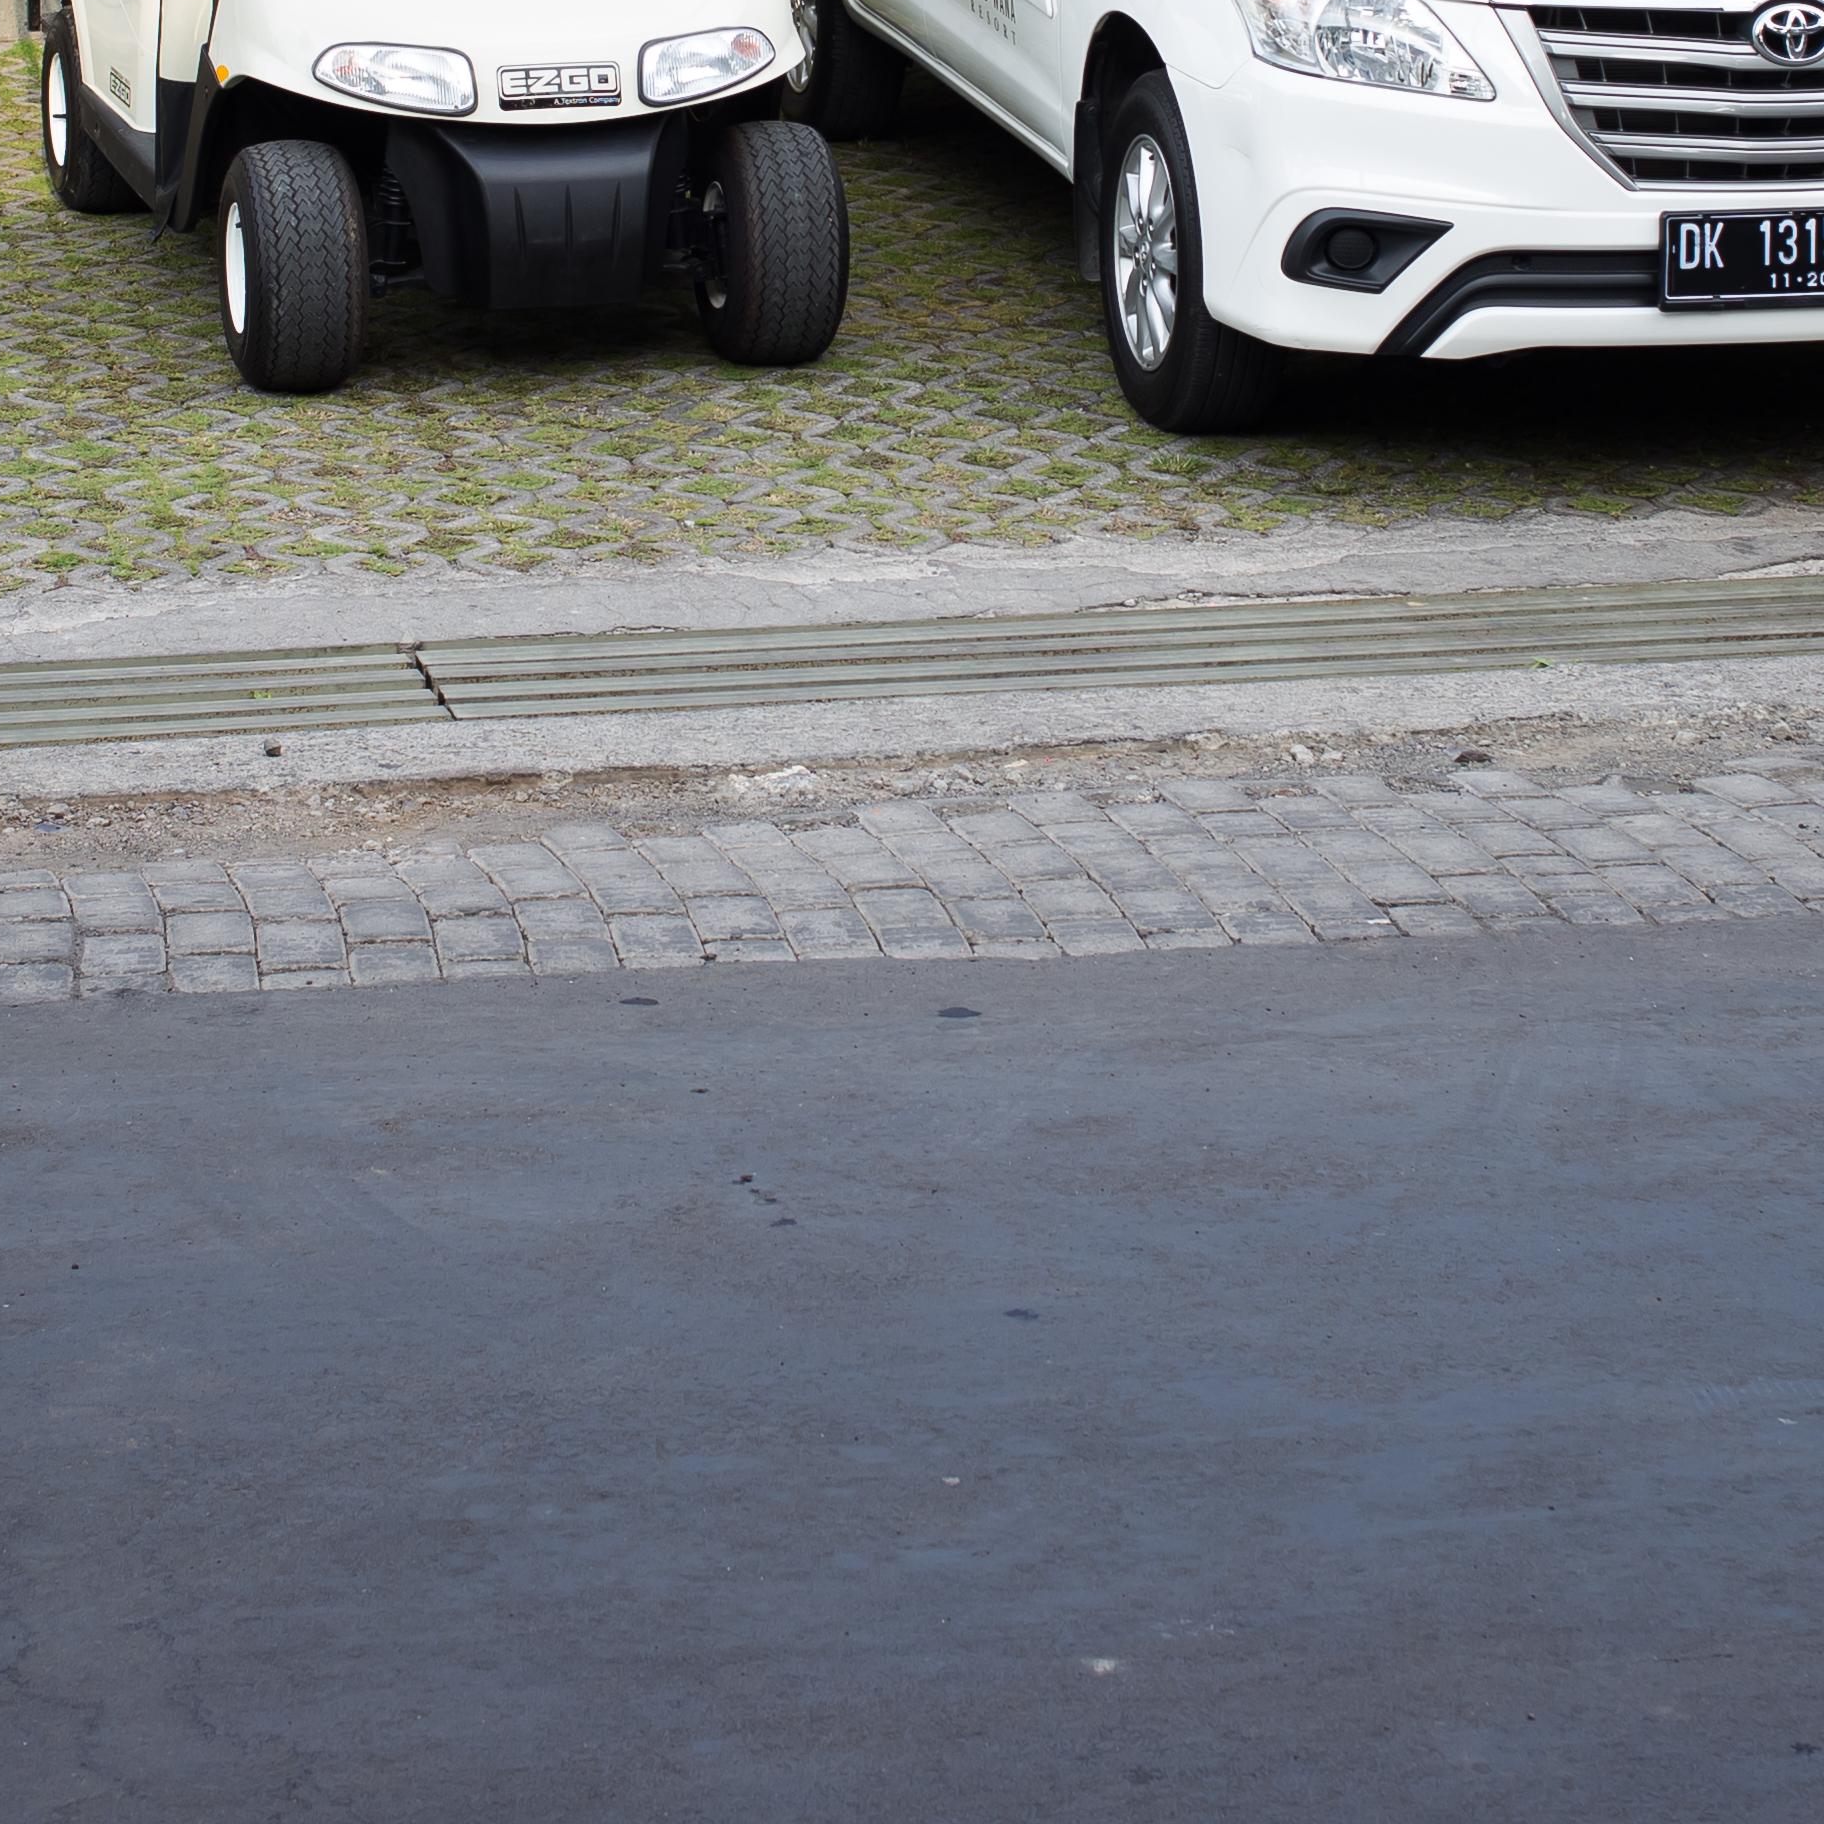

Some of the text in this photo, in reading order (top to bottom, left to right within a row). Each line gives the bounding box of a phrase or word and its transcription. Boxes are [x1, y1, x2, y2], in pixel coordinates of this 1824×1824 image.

[561, 97, 588, 106] Textron
[588, 95, 621, 105] Company
[1679, 222, 1725, 270] DK
